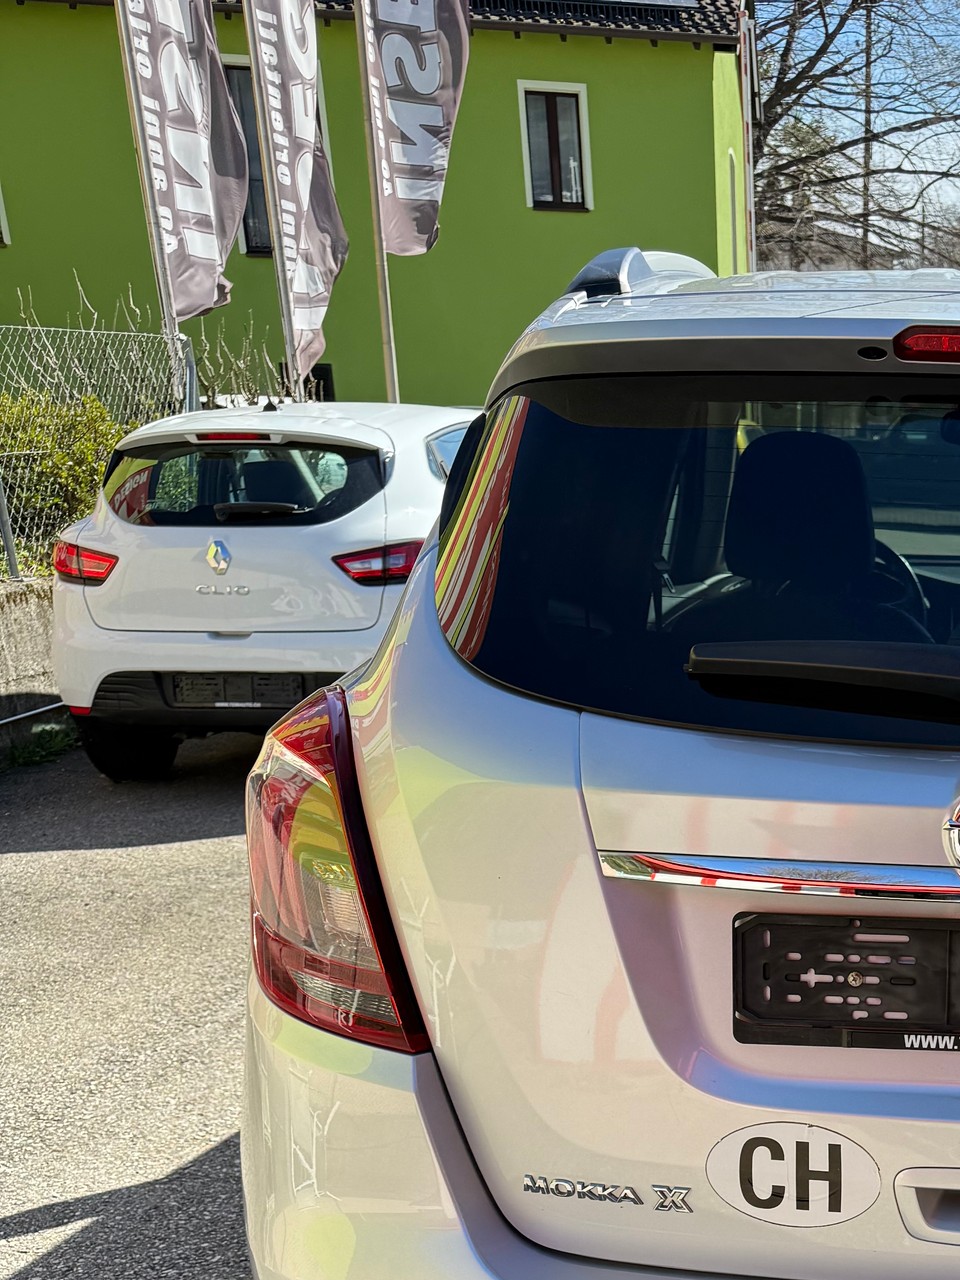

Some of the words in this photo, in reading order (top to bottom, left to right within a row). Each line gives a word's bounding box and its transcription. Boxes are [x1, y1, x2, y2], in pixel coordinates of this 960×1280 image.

[195, 585, 250, 596] CLIO
[523, 1174, 645, 1206] MOKKA
[652, 1184, 694, 1214] X
[739, 1136, 842, 1213] CH
